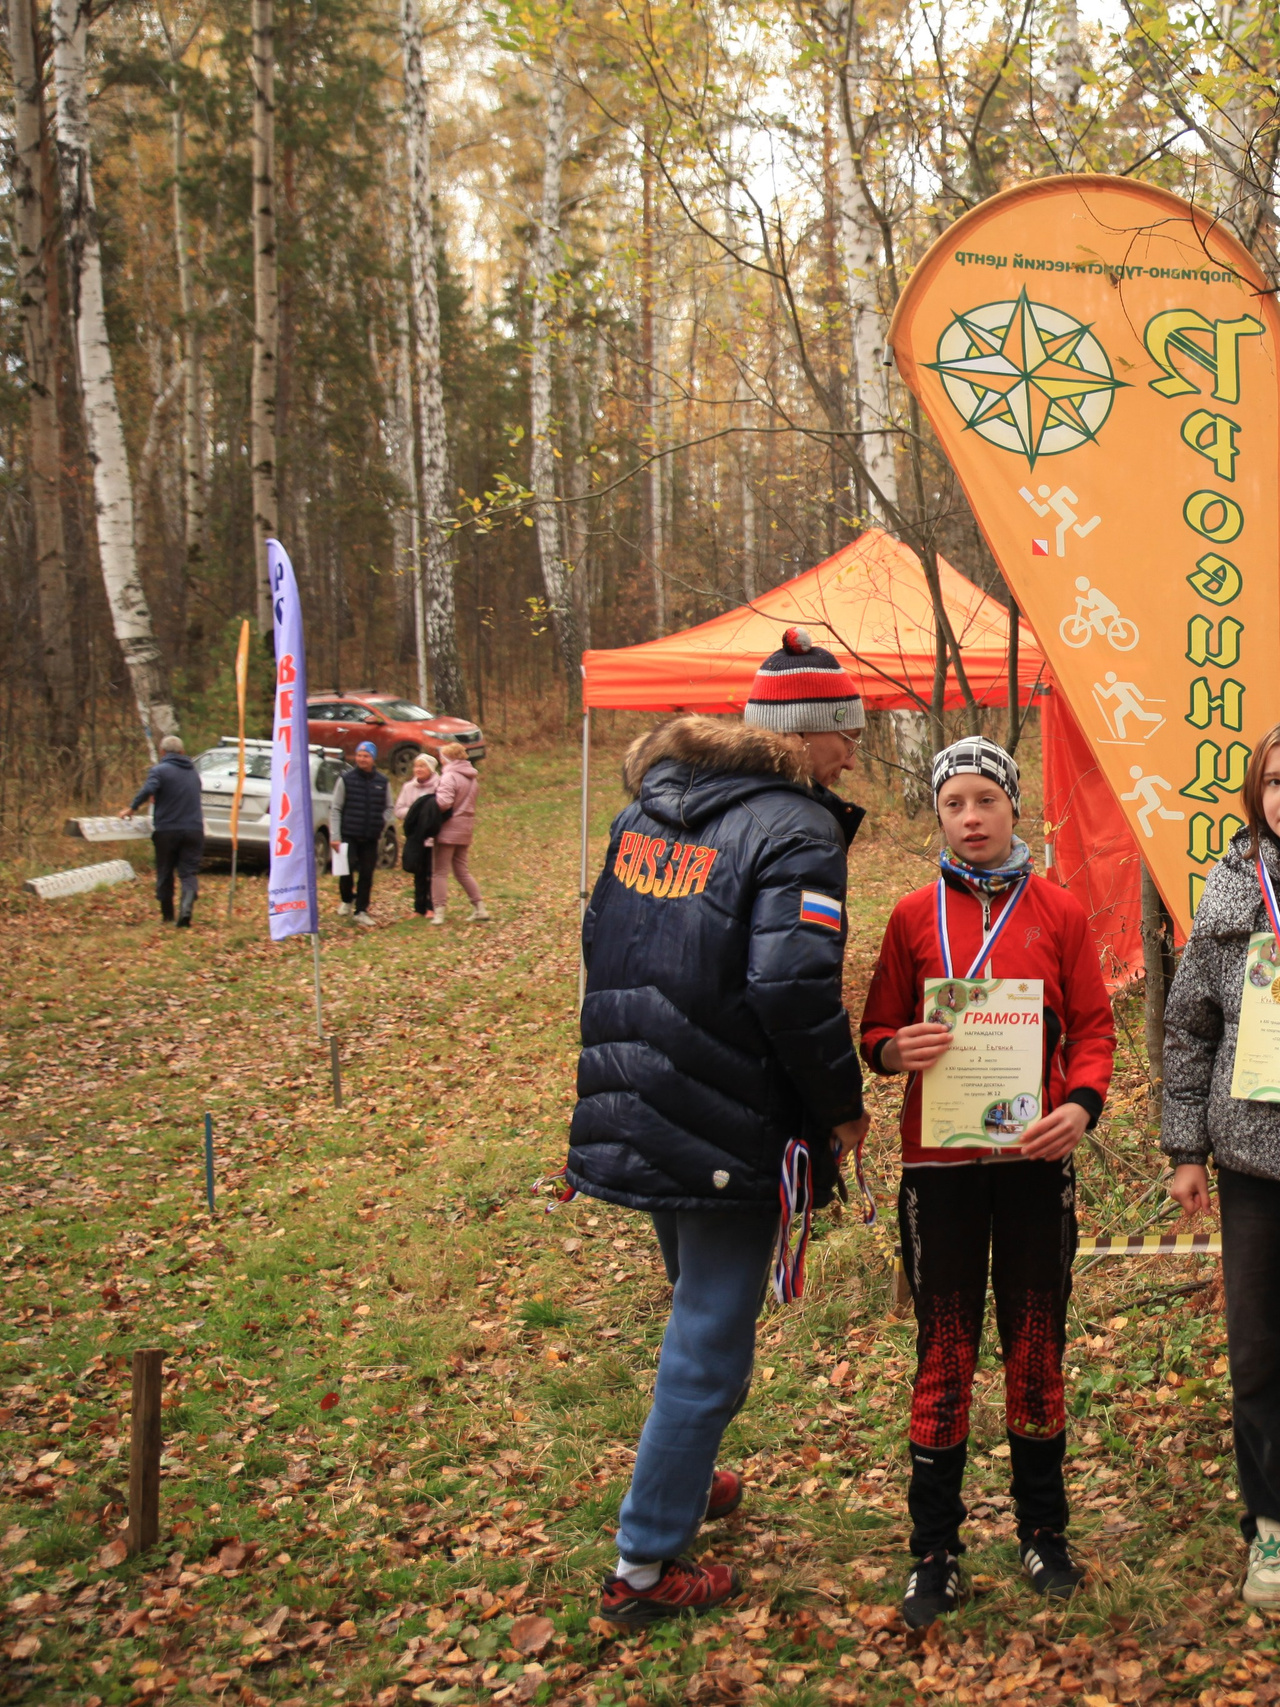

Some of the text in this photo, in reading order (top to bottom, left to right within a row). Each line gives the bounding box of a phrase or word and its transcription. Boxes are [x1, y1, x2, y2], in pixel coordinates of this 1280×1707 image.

[613, 830, 719, 899] RUSSIA
[963, 1012, 1040, 1025] ГРАМОТА
[1013, 1418, 1058, 1434] LEKI
